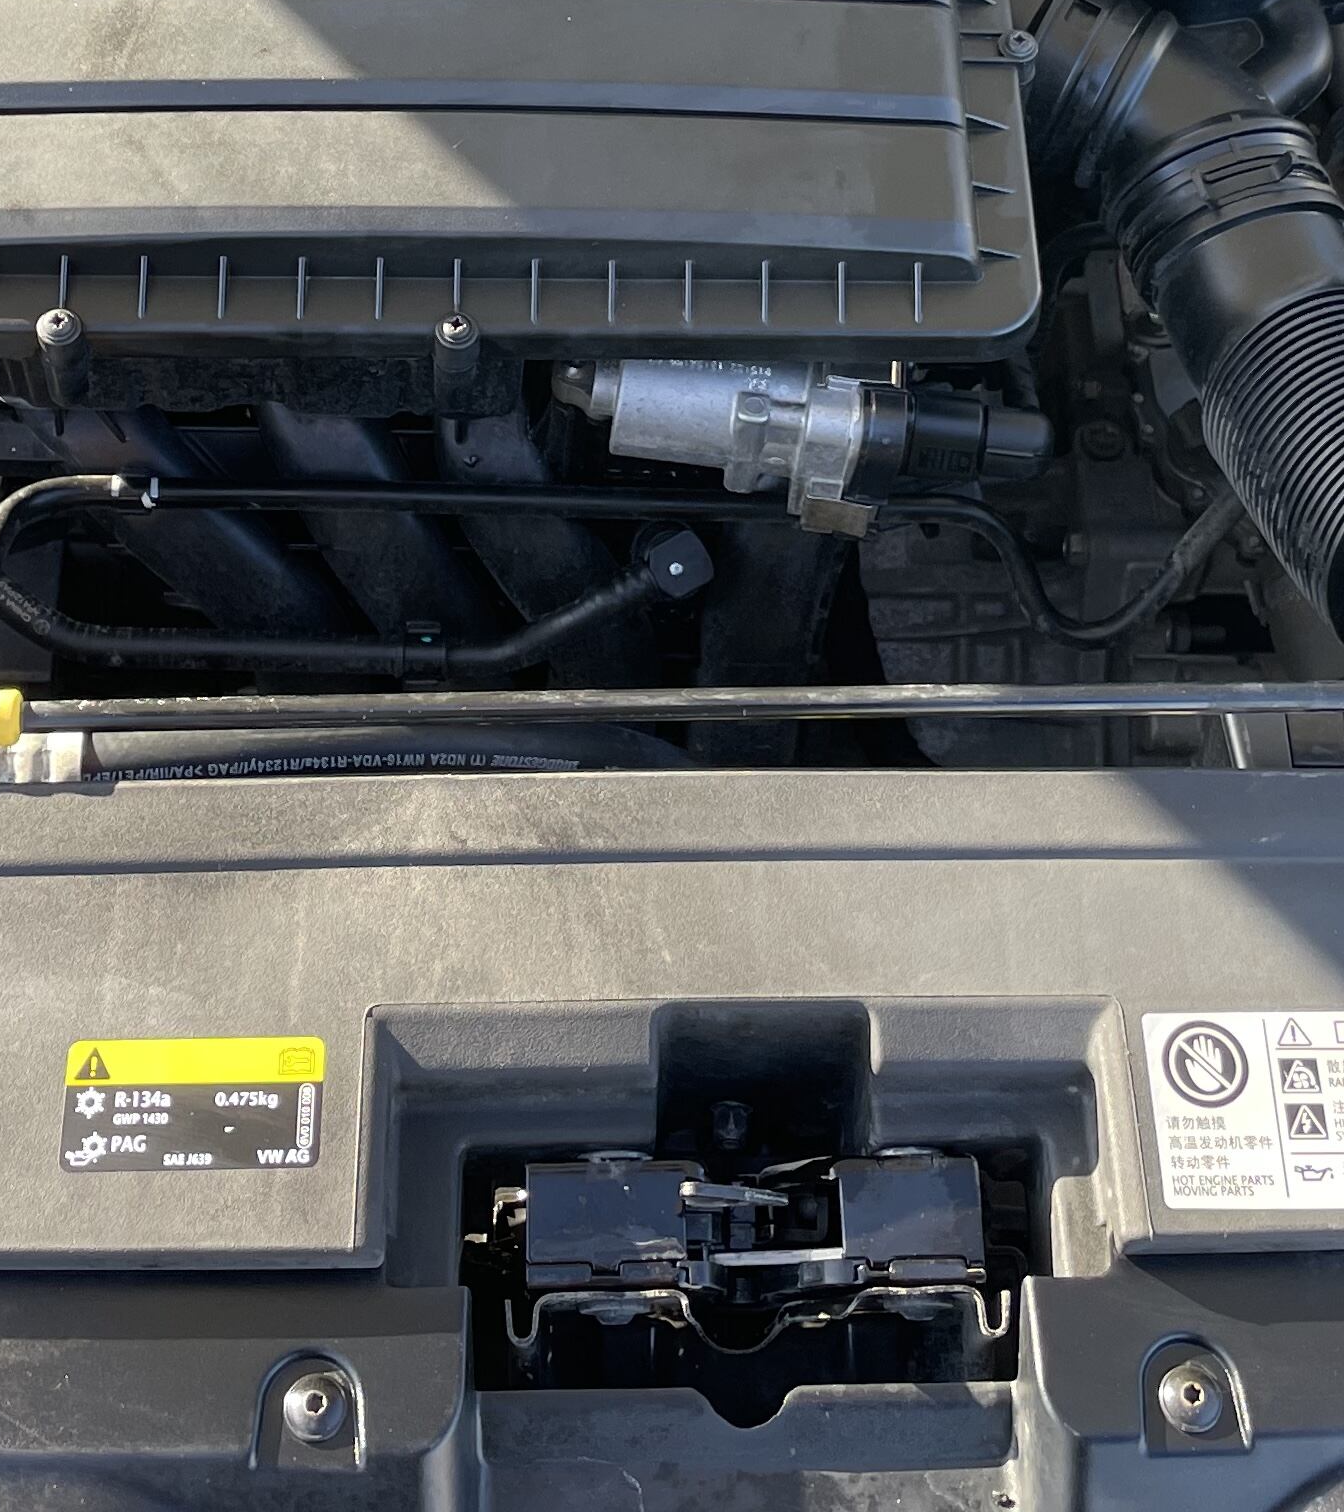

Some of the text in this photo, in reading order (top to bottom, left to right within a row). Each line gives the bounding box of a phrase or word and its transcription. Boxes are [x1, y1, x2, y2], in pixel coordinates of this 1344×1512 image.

[114, 1090, 280, 1109] R-134a 0.475kg
[112, 1113, 169, 1126] GWP 1430
[110, 1135, 147, 1153] PAG
[1168, 1135, 1274, 1150] 高温发动机零件
[163, 1153, 213, 1166] SAE J639
[257, 1148, 311, 1164] VW AG
[1171, 1155, 1231, 1170] 转动零件
[1172, 1175, 1275, 1186] HOT ENGINE PARTS
[1173, 1186, 1255, 1197] MOVING PARTS
